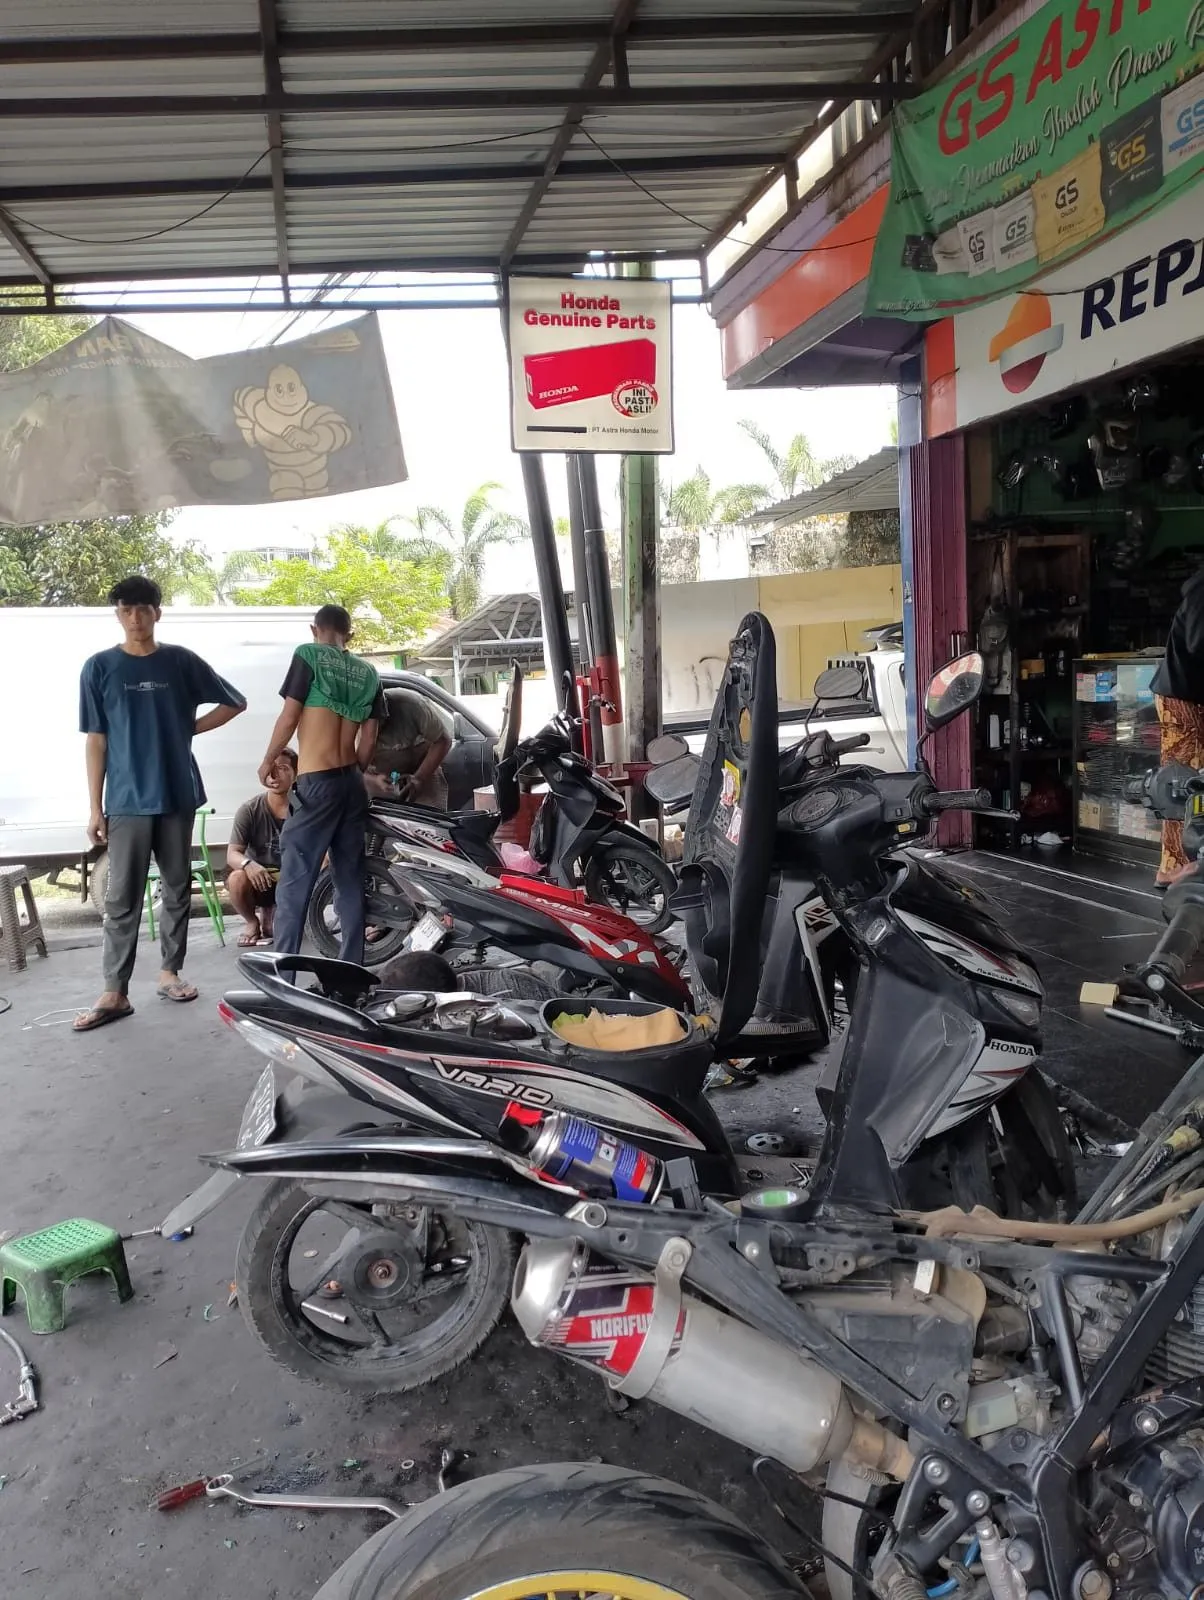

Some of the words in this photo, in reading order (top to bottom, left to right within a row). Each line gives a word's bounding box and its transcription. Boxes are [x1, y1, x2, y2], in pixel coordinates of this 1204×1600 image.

[1106, 36, 1177, 108] Puasa
[938, 38, 1020, 156] GS
[1117, 133, 1147, 170] GS
[1054, 178, 1079, 209] GS
[1005, 216, 1027, 241] GS
[968, 231, 985, 254] GS
[560, 292, 620, 311] Honda
[523, 309, 601, 328] Genuine
[606, 314, 656, 330] Parts
[539, 385, 579, 400] HONDA
[624, 396, 654, 405] PASTI
[632, 388, 646, 397] INI
[626, 405, 652, 414] ASLI!
[641, 427, 659, 435] Motor
[990, 1041, 1035, 1057] HONDA
[429, 1056, 553, 1105] VARIO
[590, 1313, 653, 1339] NORIFU
